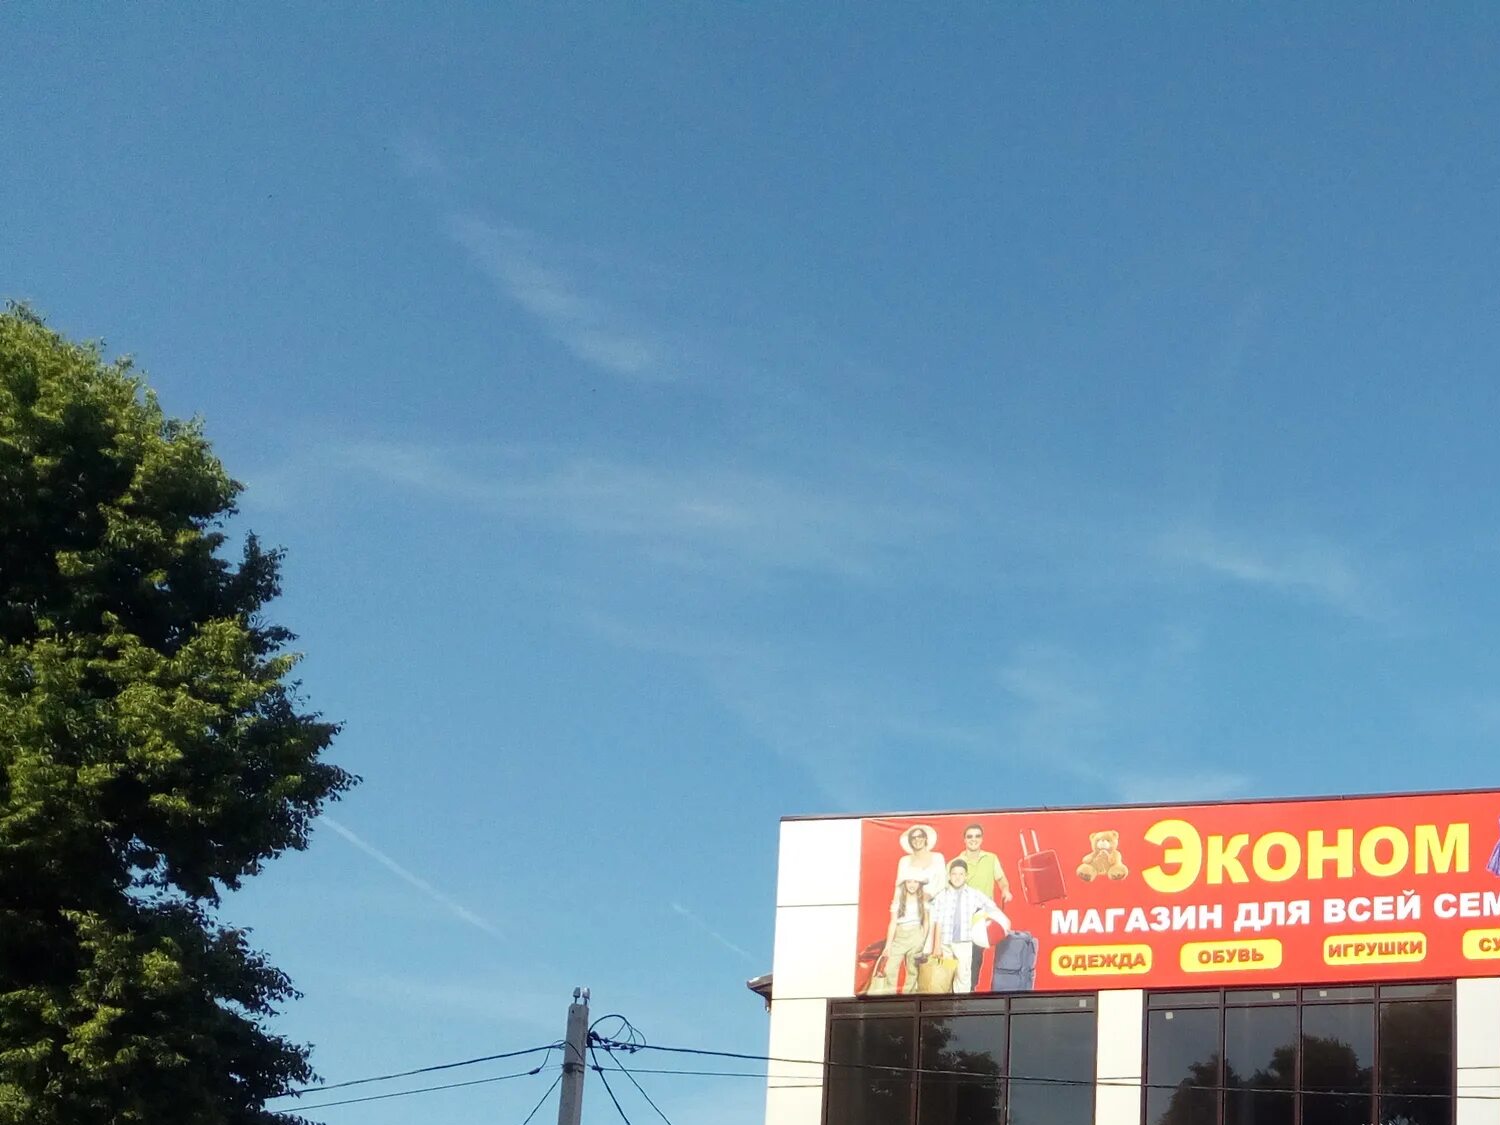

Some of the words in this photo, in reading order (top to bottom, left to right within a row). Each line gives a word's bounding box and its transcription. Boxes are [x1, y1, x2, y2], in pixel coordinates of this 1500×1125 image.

[1050, 904, 1222, 936] МАГАЗИН
[1233, 900, 1310, 933] ДЛЯ
[1322, 889, 1423, 924] ВСЕЙ
[1197, 946, 1265, 965] ОБУВЬ
[1327, 938, 1424, 958] ИГРУШКИ
[1057, 951, 1147, 971] ОДЕЖДА
